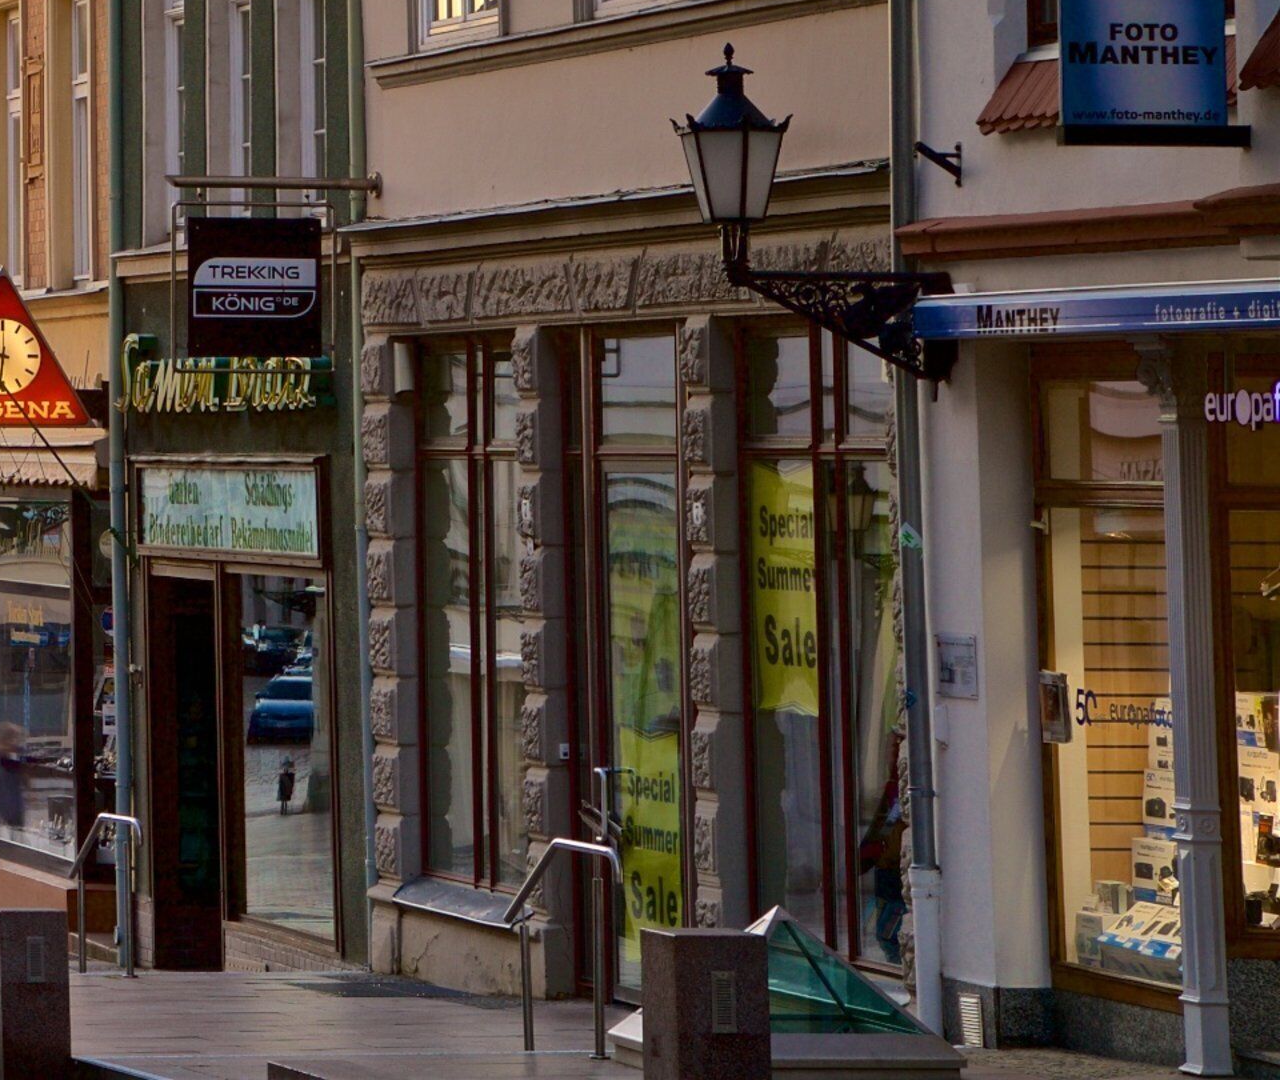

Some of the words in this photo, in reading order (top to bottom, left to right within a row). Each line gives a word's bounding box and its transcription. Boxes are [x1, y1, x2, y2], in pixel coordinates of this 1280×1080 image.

[1109, 23, 1179, 42] FOTO
[1068, 41, 1218, 65] MANTHEY
[1072, 108, 1221, 124] www.foto-manthey.de
[208, 265, 300, 280] TREKKING
[976, 304, 1061, 334] MANTHEY
[1155, 302, 1226, 322] fotografie
[759, 505, 813, 546] Special
[763, 614, 816, 668] Sale
[625, 815, 678, 855] Summer
[631, 871, 679, 927] Sale
